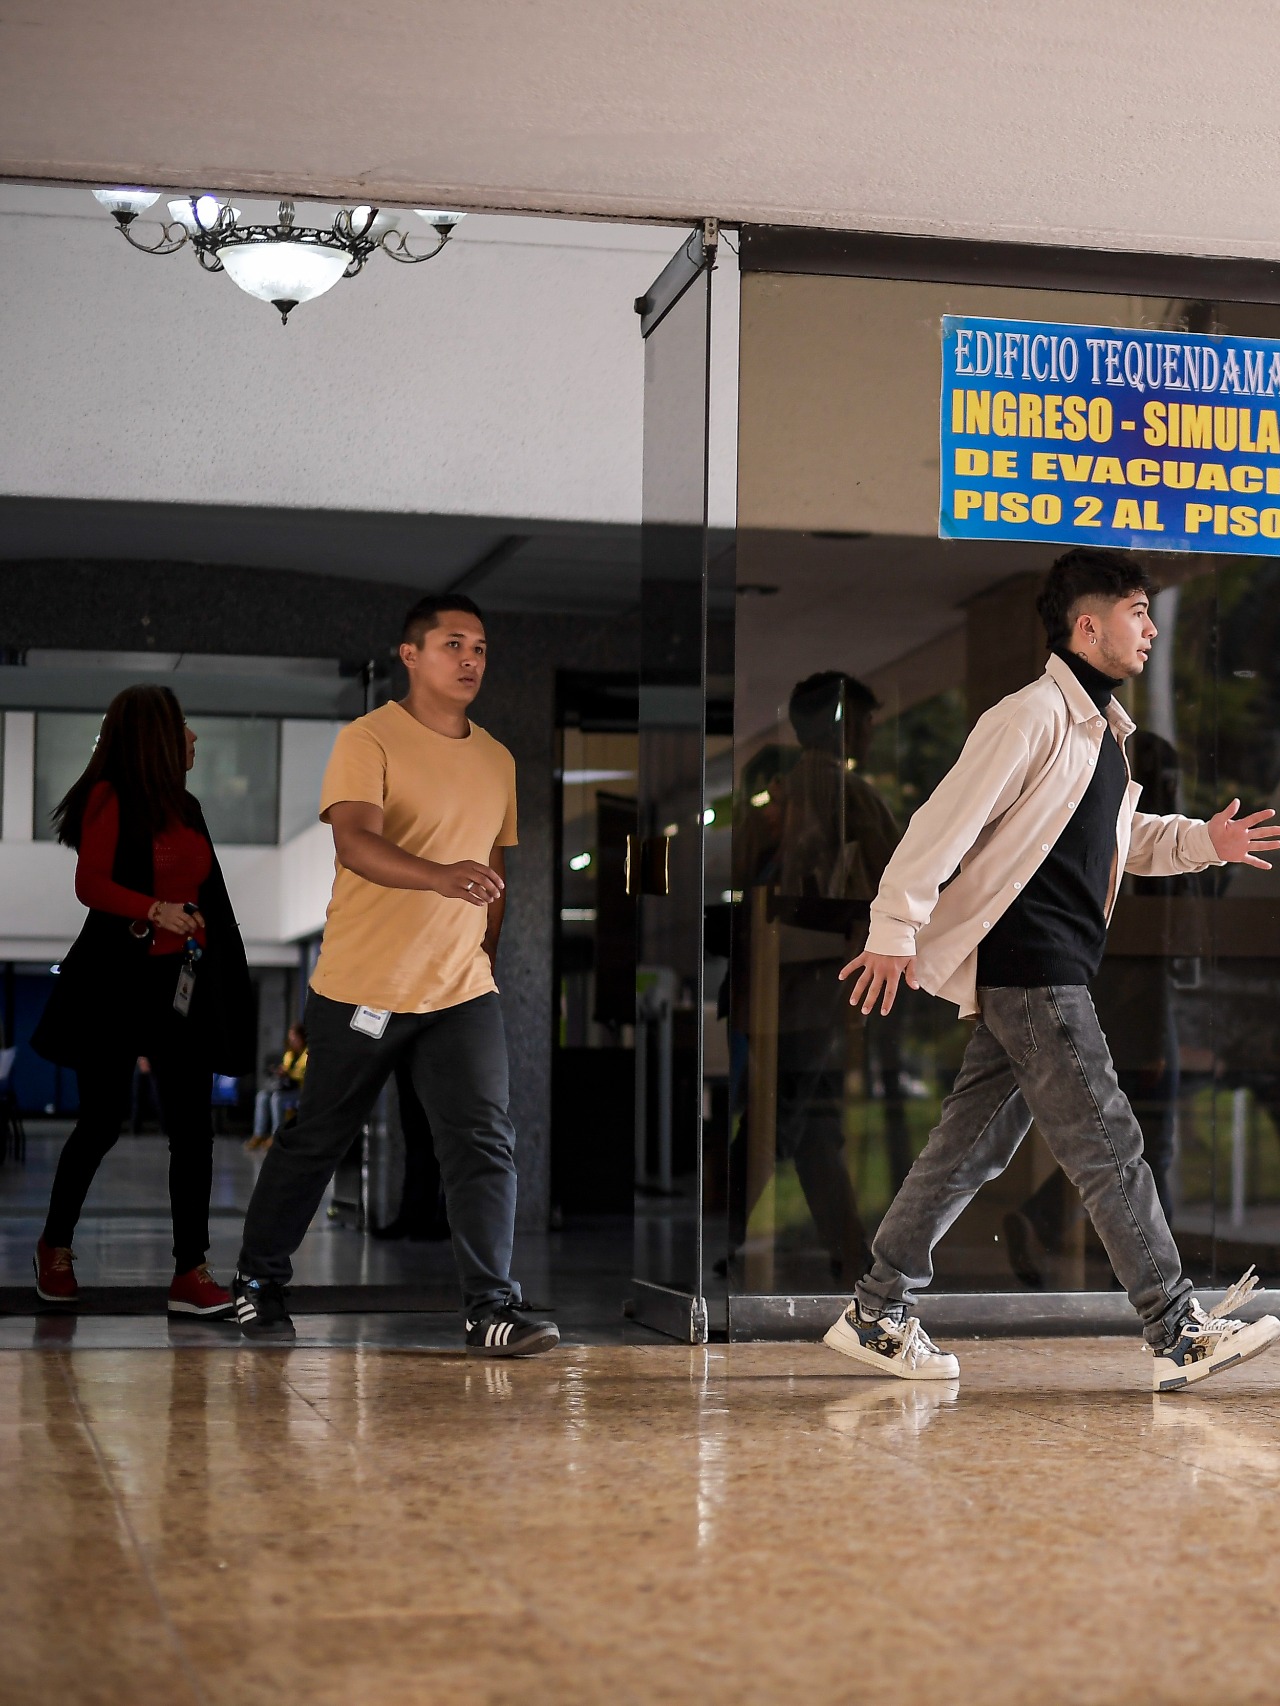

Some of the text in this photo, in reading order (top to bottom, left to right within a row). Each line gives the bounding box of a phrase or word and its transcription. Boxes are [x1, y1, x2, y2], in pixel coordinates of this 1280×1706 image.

[955, 329, 1079, 383] EDIFICIO
[951, 389, 1113, 444] INGRESO
[1121, 419, 1137, 432] -
[954, 448, 1018, 478] DE
[953, 489, 1062, 525] PISO
[1072, 496, 1103, 527] 2
[1111, 499, 1165, 532] AL
